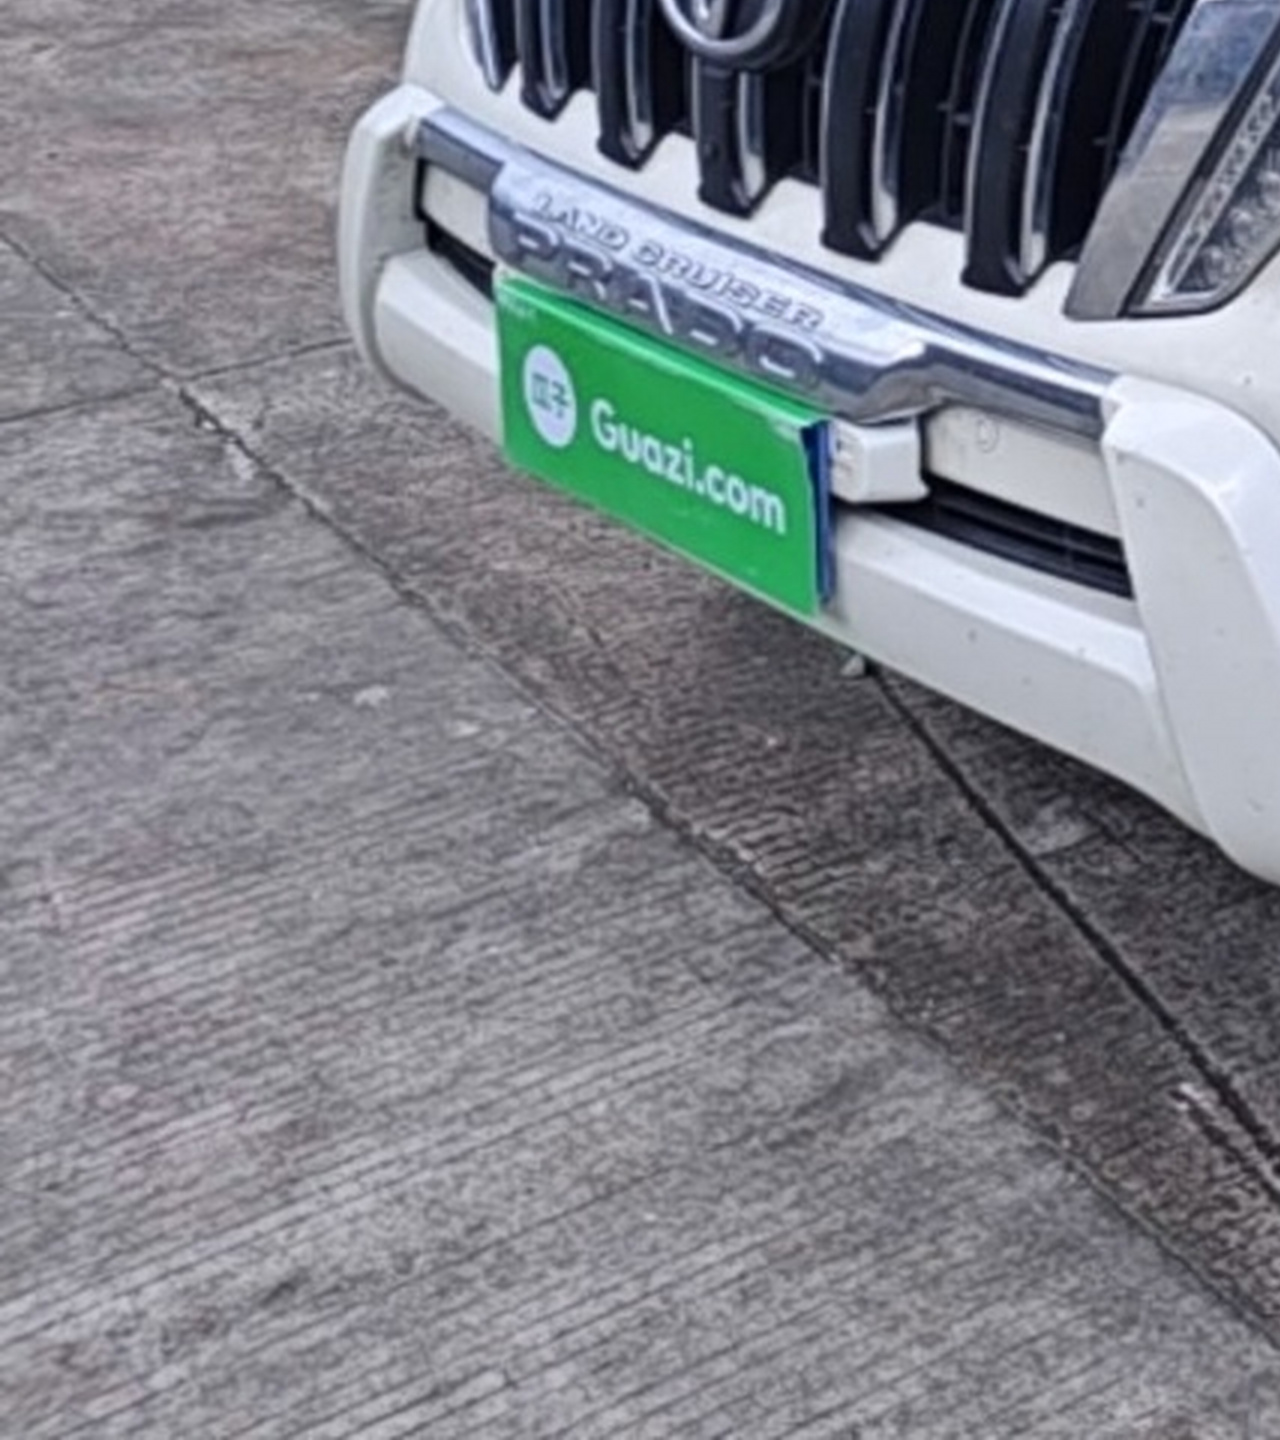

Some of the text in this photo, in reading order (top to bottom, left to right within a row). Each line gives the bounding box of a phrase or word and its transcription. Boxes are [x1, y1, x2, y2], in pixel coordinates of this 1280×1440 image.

[514, 210, 828, 384] PRADO
[533, 192, 826, 329] LAND CRUISER
[590, 398, 786, 535] Guazi.com
